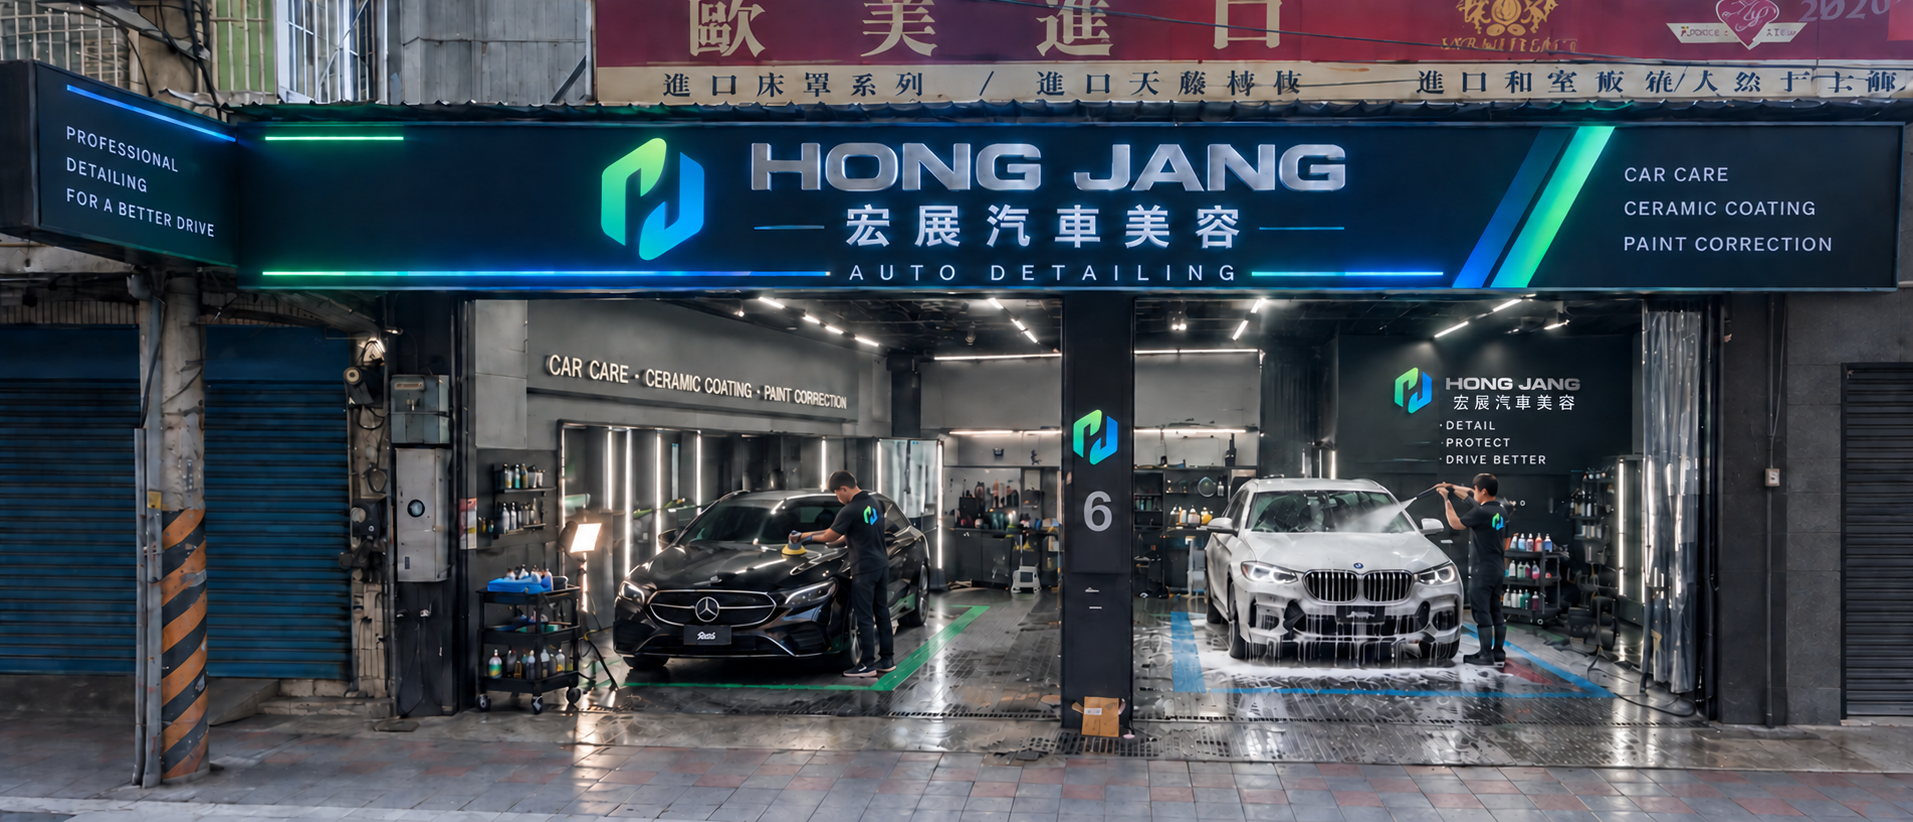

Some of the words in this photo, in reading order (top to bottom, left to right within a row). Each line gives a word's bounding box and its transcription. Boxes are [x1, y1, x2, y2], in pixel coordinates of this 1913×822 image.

[663, 72, 922, 98] 進口床罩系列
[66, 126, 178, 173] PROFESSIONAL
[66, 157, 147, 193] DETAILING
[751, 142, 1041, 192] HONG
[1073, 142, 1346, 193] JANG
[1624, 167, 1665, 182] CAR
[1674, 167, 1729, 182] CARE
[66, 188, 98, 209] FOR
[103, 198, 113, 213] A
[118, 201, 172, 227] BETTER
[177, 216, 215, 238] DRIVE
[1624, 201, 1717, 216] CERAMIC
[1725, 201, 1816, 216] COATING
[846, 204, 1241, 249] 宏展汽車美容
[1624, 236, 1687, 251] PAINT
[1694, 236, 1833, 252] CORRECTION
[848, 265, 957, 282] AUTO
[991, 265, 1236, 282] DETAILING
[549, 354, 582, 378] CAR
[589, 359, 629, 384] CARE
[645, 368, 701, 393] CERAMIC
[704, 377, 752, 398] COATING
[764, 384, 792, 403] PAINT
[794, 388, 847, 409] CORRECTION
[1445, 377, 1513, 391] HONG
[1518, 377, 1581, 391] JANG
[1453, 394, 1575, 411] 宏展汽車美容
[1446, 420, 1496, 430] DETAIL
[1446, 437, 1510, 448] PROTECT
[1446, 455, 1487, 465] DRIVE
[1493, 455, 1547, 465] BETTER
[1083, 491, 1113, 532] 6
